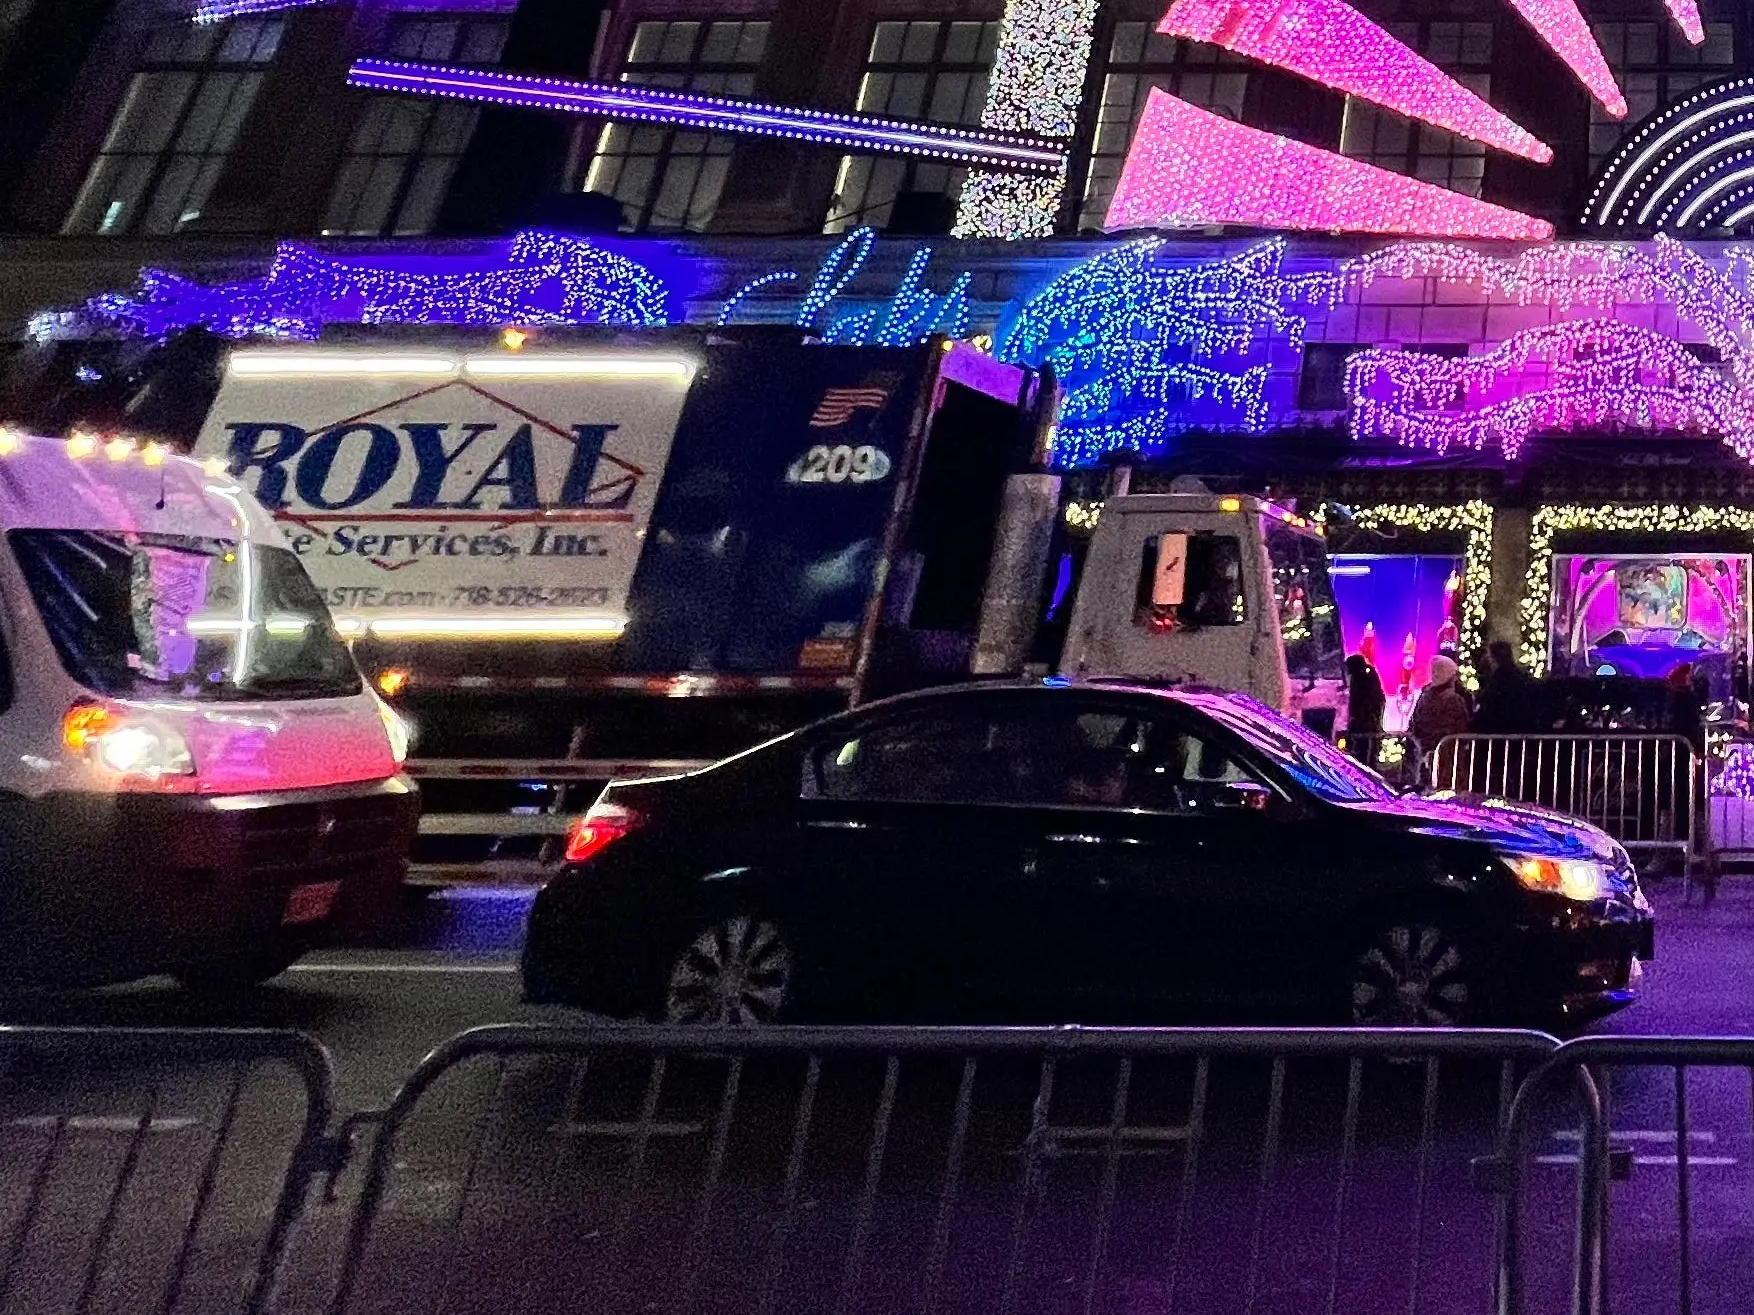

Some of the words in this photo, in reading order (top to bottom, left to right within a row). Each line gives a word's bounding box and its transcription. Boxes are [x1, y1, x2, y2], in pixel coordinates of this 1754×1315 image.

[225, 422, 641, 511] ROYAL
[802, 444, 877, 484] 209
[528, 525, 610, 557] Inc.
